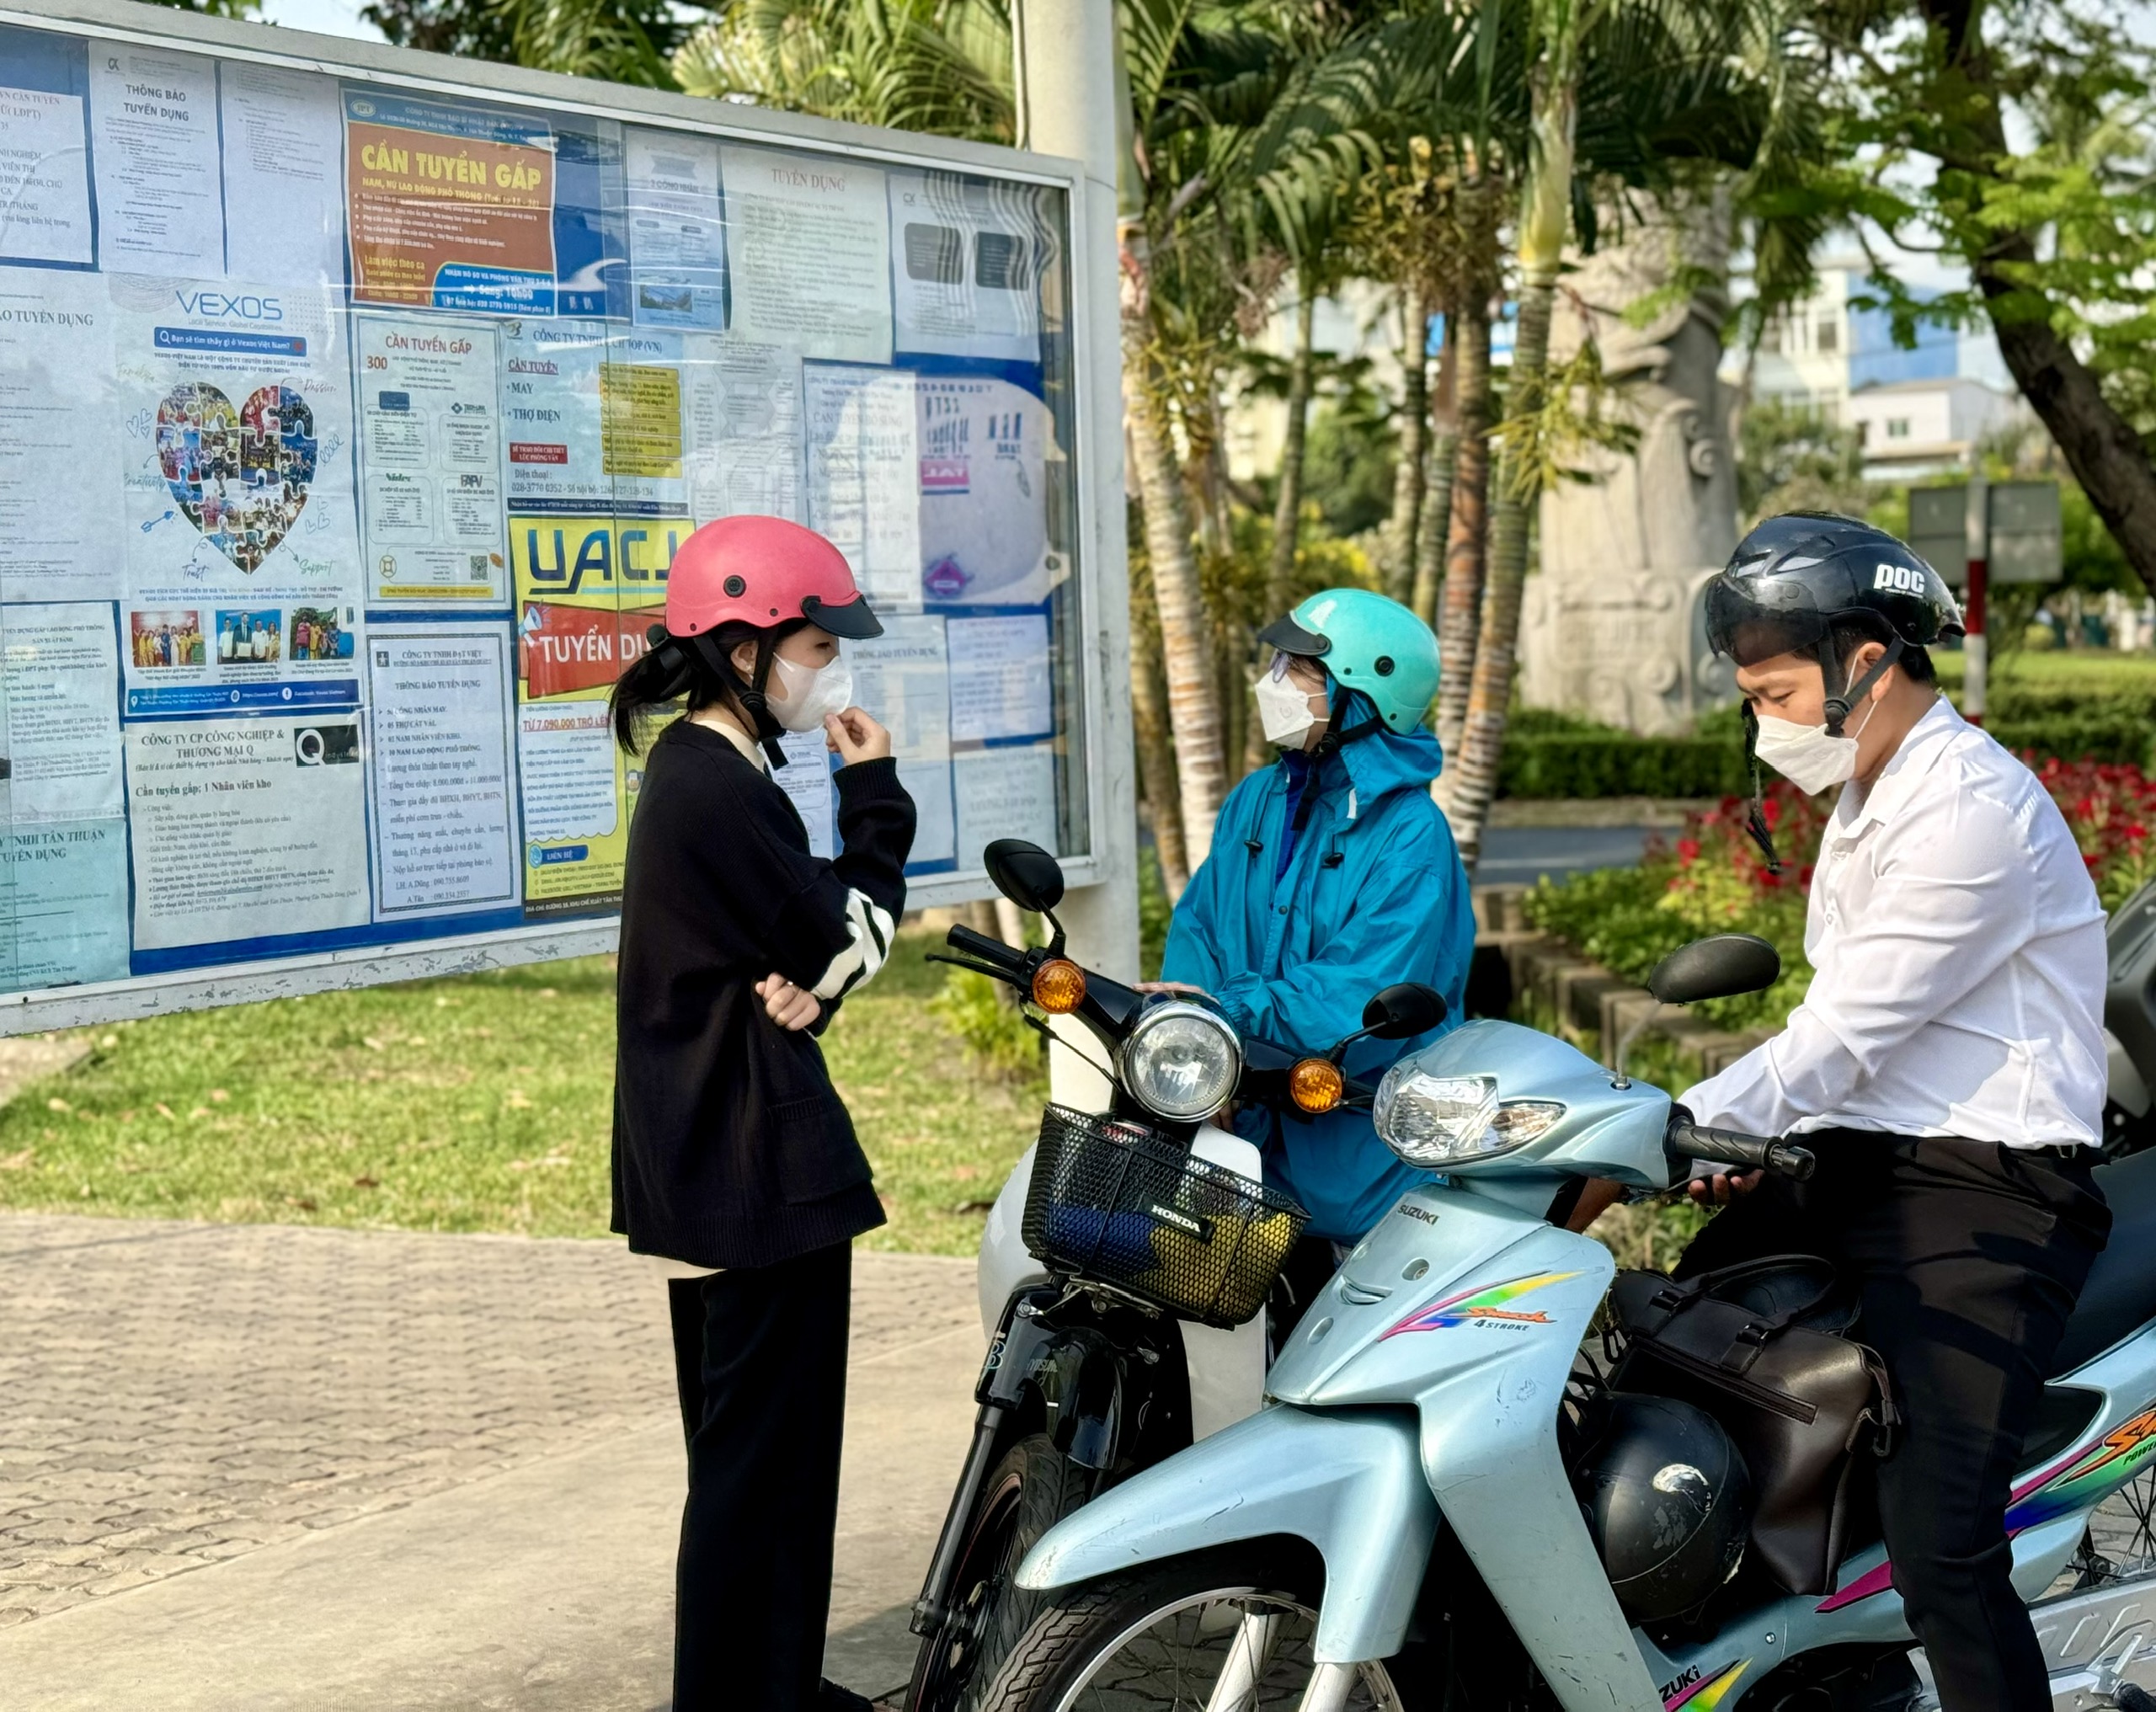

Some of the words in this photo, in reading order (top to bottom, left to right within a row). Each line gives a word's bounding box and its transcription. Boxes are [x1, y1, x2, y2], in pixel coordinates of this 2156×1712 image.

[415, 150, 488, 185] TUYỂN
[176, 290, 283, 320] VEXOS
[58, 313, 93, 328] DỤNG
[367, 355, 387, 370] 300
[511, 382, 533, 394] MAY
[299, 558, 336, 578] Support
[539, 624, 611, 663] TUYỂN
[141, 733, 172, 746] CÔNG
[173, 734, 188, 744] TY
[189, 733, 203, 744] CP
[246, 745, 254, 756] Q
[136, 782, 154, 797] Cần
[156, 781, 180, 798] tuyển
[205, 782, 209, 792] 1
[211, 781, 235, 792] Nhân
[236, 779, 254, 791] viên
[256, 779, 272, 789] kho
[35, 848, 67, 863] DỤNG
[1151, 1204, 1200, 1233] HONDA
[1397, 1204, 1439, 1225] SUZUKI
[1486, 1322, 1530, 1331] STROKE
